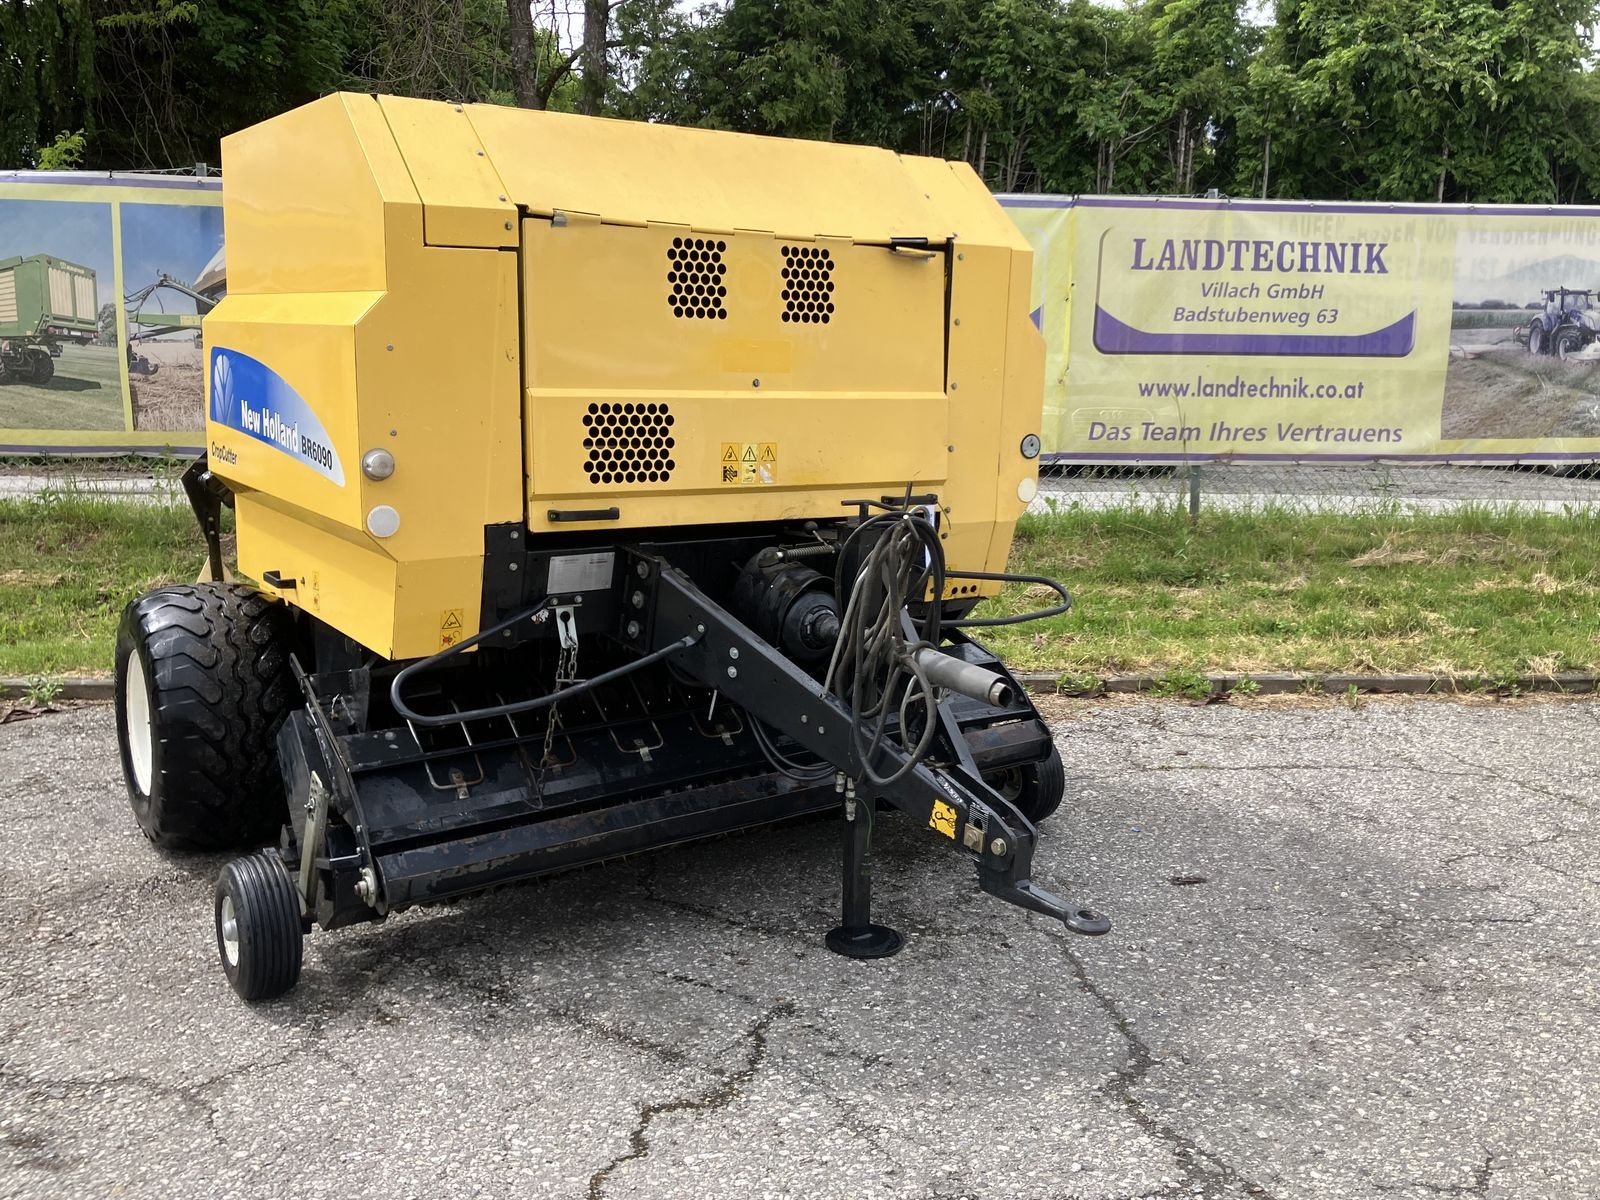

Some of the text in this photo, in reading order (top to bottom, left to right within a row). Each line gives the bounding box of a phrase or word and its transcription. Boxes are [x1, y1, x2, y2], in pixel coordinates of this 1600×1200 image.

[1130, 238, 1389, 274] LANDTECHNIK
[1200, 282, 1325, 300] Villach GmbH
[1173, 306, 1339, 327] Badstubenweg 63
[1138, 375, 1364, 399] www.landtechnik.co.at
[241, 399, 333, 471] New Holland BR6090
[1088, 421, 1403, 443] Das Team Ihres Vertrauens
[211, 441, 238, 465] CropCutter
